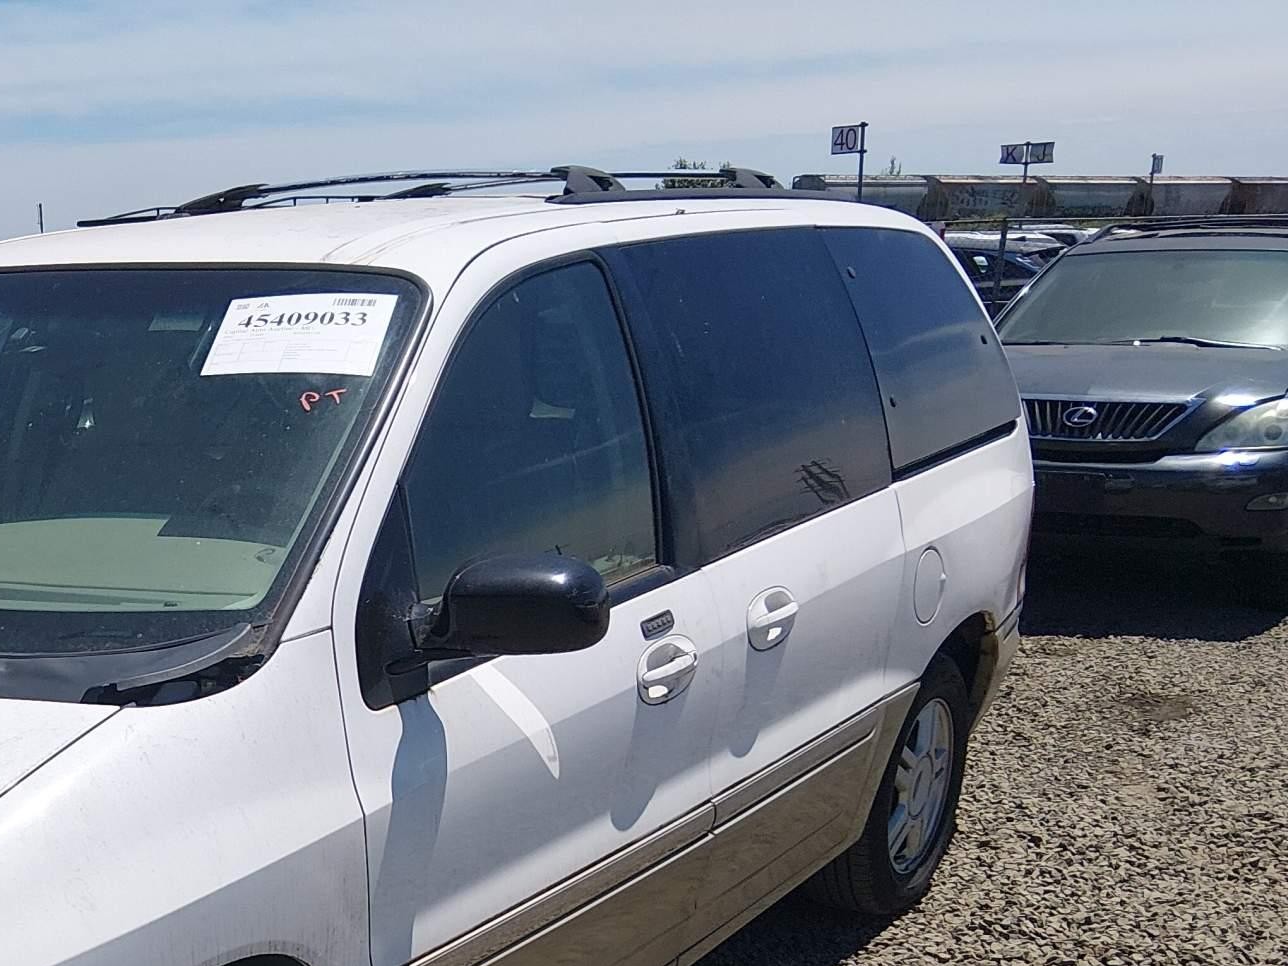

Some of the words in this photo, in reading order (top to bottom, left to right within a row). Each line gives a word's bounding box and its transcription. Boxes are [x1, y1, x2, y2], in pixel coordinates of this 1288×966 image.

[833, 128, 857, 151] 40
[1006, 146, 1017, 162] K
[1036, 144, 1046, 162] J
[238, 311, 368, 329] 45409033
